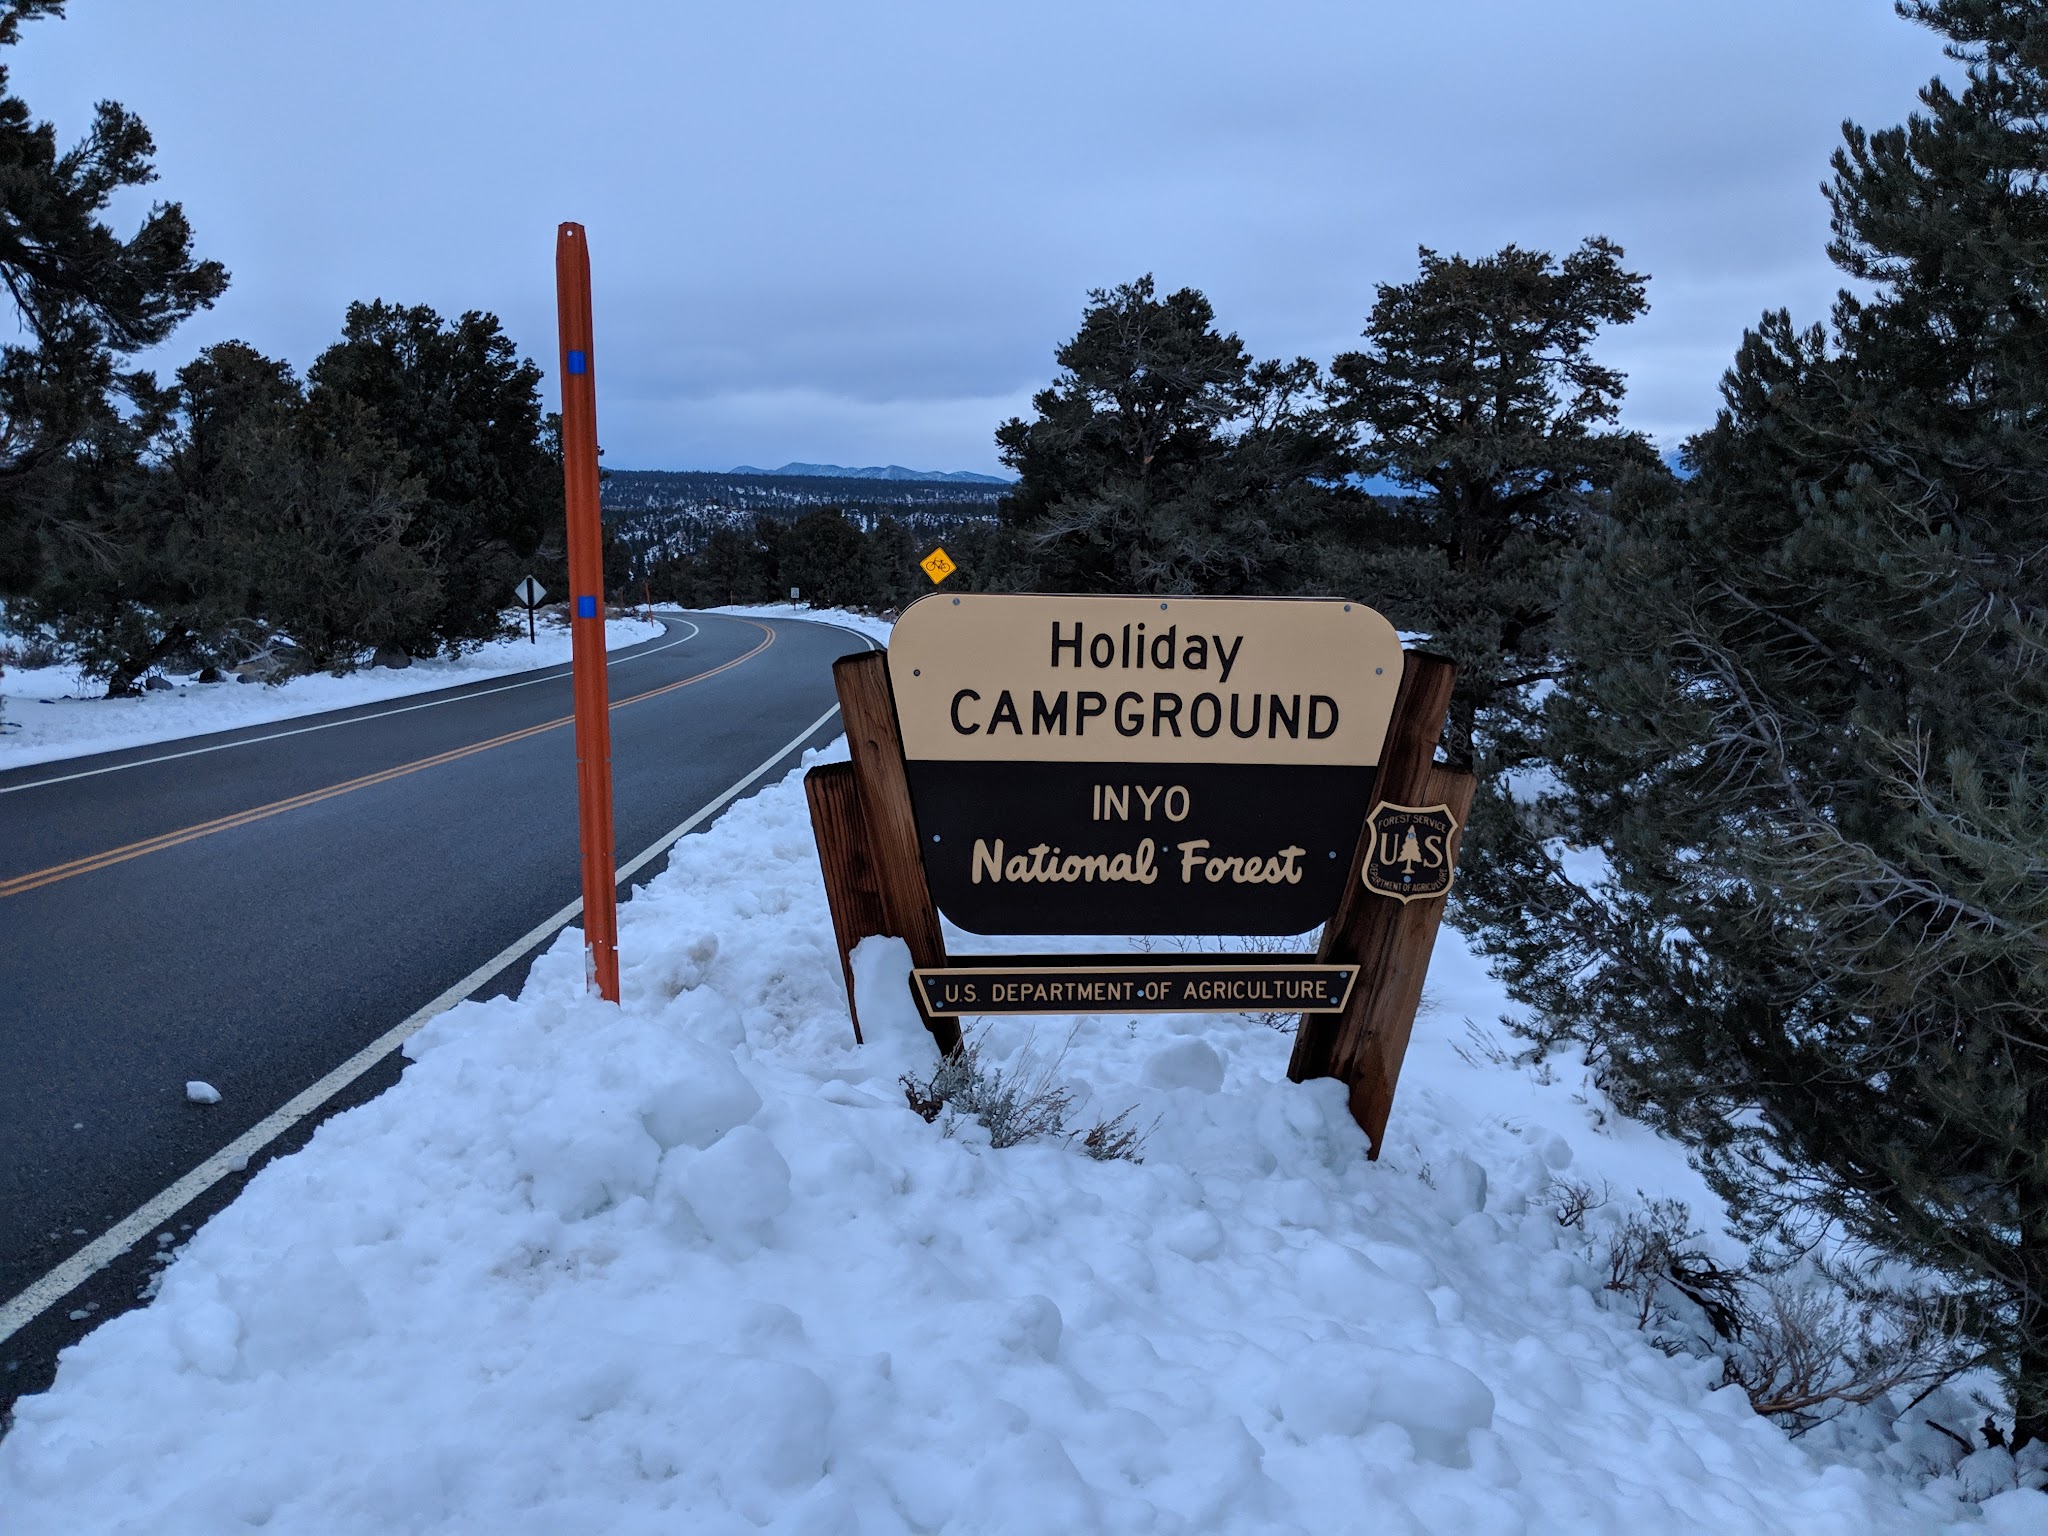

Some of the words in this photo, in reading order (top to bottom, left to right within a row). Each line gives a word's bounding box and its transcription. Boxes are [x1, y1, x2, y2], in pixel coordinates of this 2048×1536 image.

[1050, 621, 1244, 684] Holiday
[950, 688, 1339, 740] CAMPGROUND
[1092, 784, 1190, 822] INYO
[1379, 815, 1410, 829] FOREST
[1413, 815, 1447, 834] SERVICE
[971, 837, 1158, 885] National
[1176, 839, 1307, 884] Forest
[1370, 864, 1401, 891] DEPARTMENT
[1402, 883, 1410, 891] OF
[1412, 868, 1448, 892] AGRICULTURE
[945, 984, 981, 1003] U.S.
[992, 982, 1135, 1002] DEPARTMENT
[1145, 981, 1172, 1000] OF
[1183, 980, 1328, 1000] AGRICULTURE
